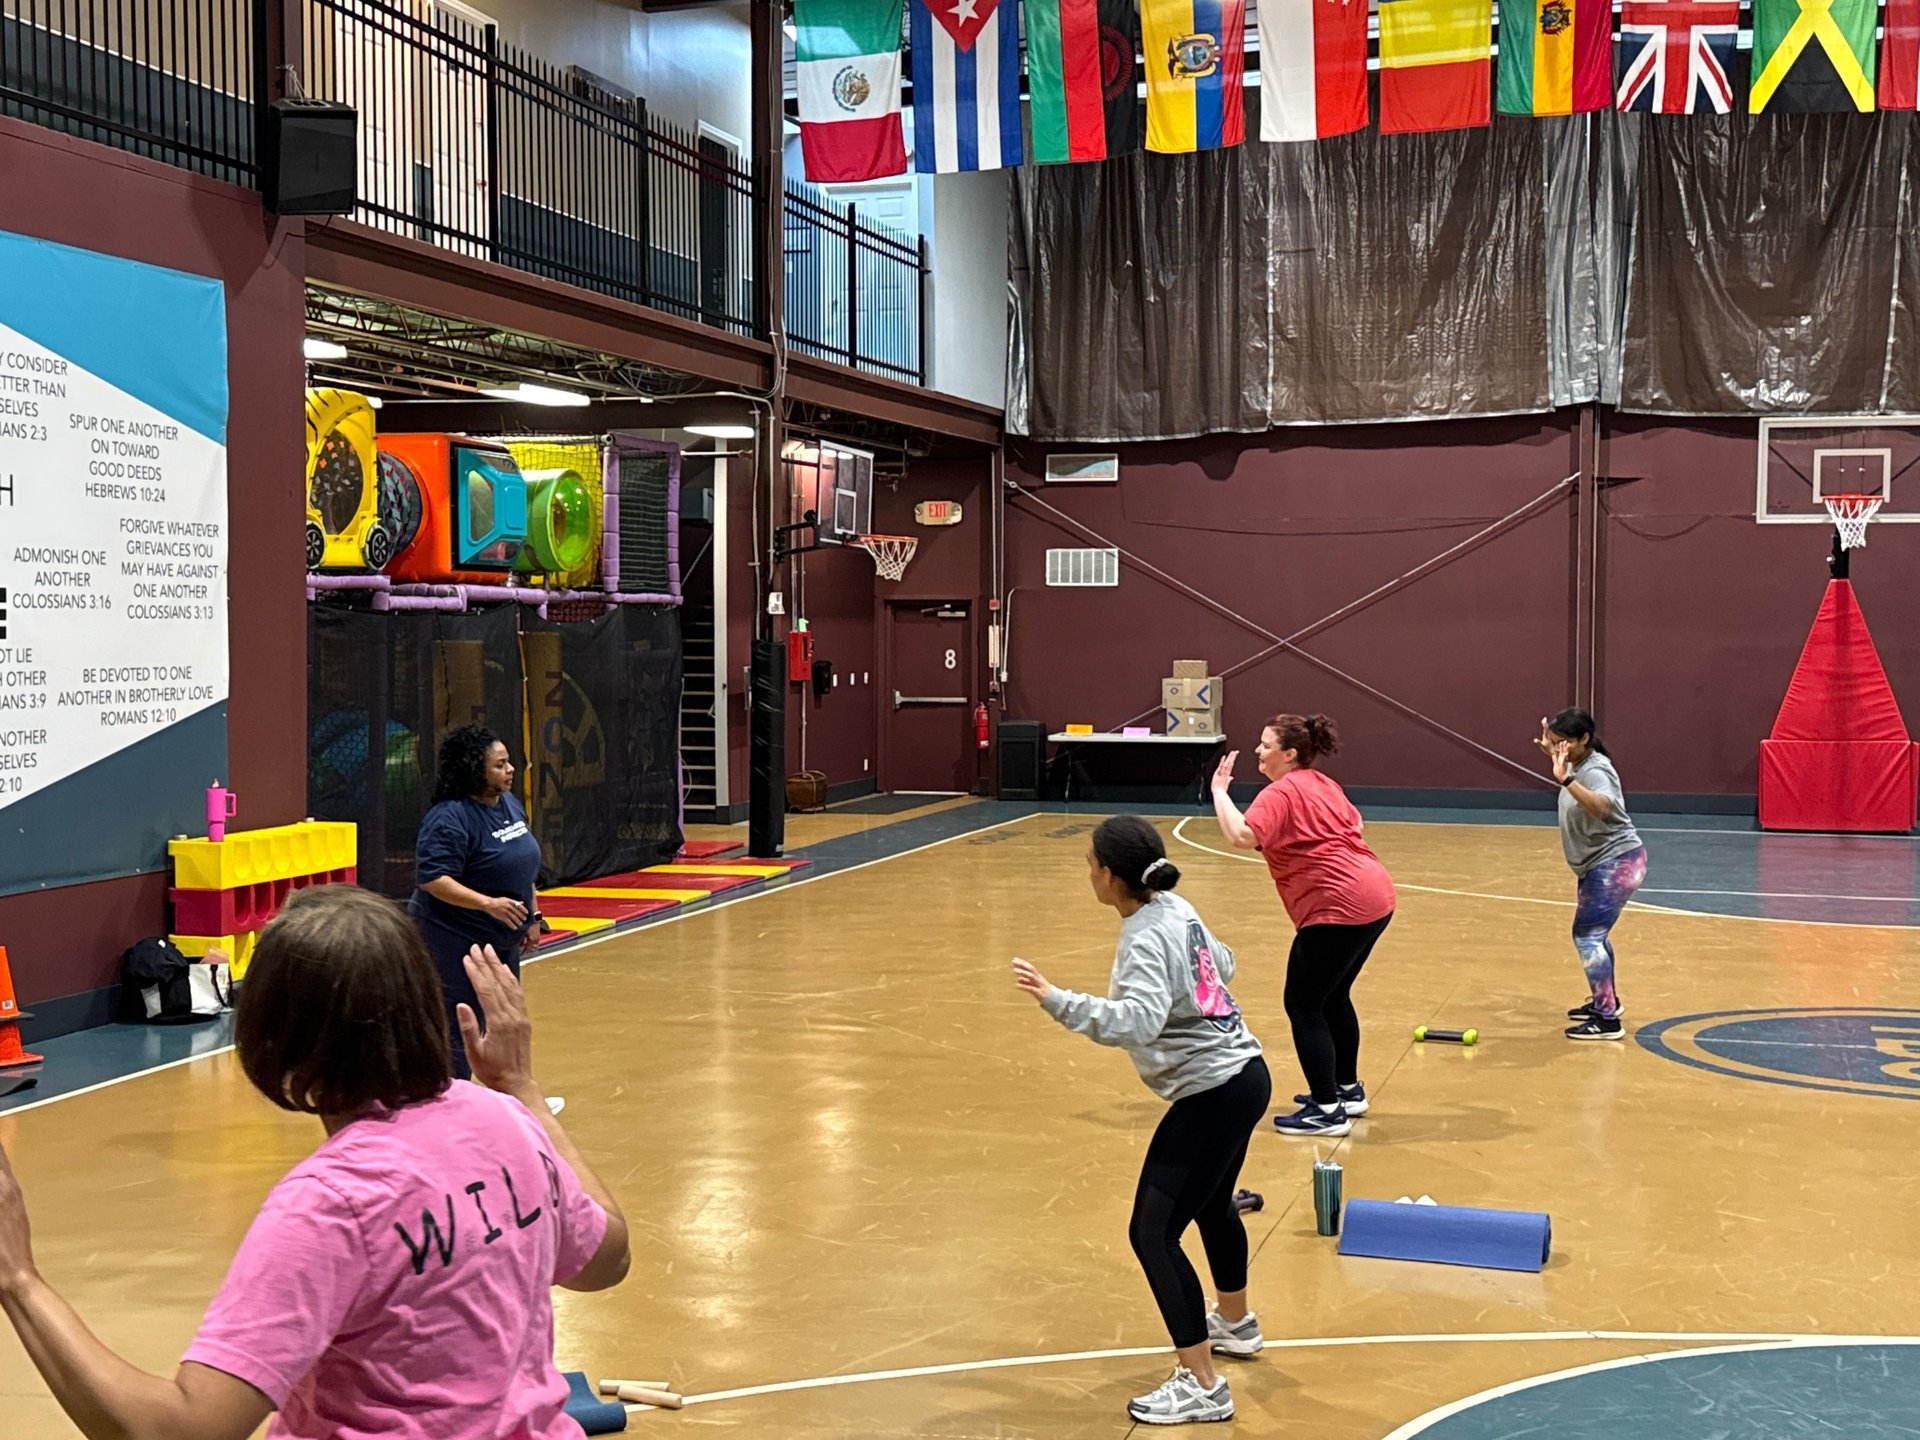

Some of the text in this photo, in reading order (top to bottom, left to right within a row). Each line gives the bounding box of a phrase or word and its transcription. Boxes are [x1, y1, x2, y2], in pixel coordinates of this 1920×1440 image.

[7, 352, 68, 376] CONSIDER
[0, 375, 66, 398] TTER THAN
[30, 424, 47, 441] 2:3
[69, 413, 179, 441] SPUR ONE ANOTHER
[91, 438, 160, 460] ON TOWARD
[89, 460, 162, 481] GOOD DEEDS
[85, 482, 166, 503] HEBREWS 10:24
[928, 502, 948, 518] EXIT
[119, 518, 219, 538] FORGIVE WHATEVER
[13, 547, 107, 566] ADMONISH ONE
[126, 540, 213, 558] GRIEVANCES YOU
[34, 571, 91, 587] ANOTHER
[121, 562, 219, 579] MAY HAVE AGAINST
[133, 583, 208, 599] ONE ANOTHER
[12, 593, 112, 610] COLOSSIANS 3:16
[127, 604, 214, 620] COLOSSIANS 3:13
[16, 648, 33, 663] LIE
[944, 648, 957, 669] 8
[6, 670, 47, 687] OTHER
[83, 666, 192, 683] BE DEVOTED TO ONE
[29, 693, 47, 709] 3:9
[57, 686, 214, 706] ANOTHER IN BROTHERLY LOVE
[100, 708, 177, 726] ROMANS 12:10
